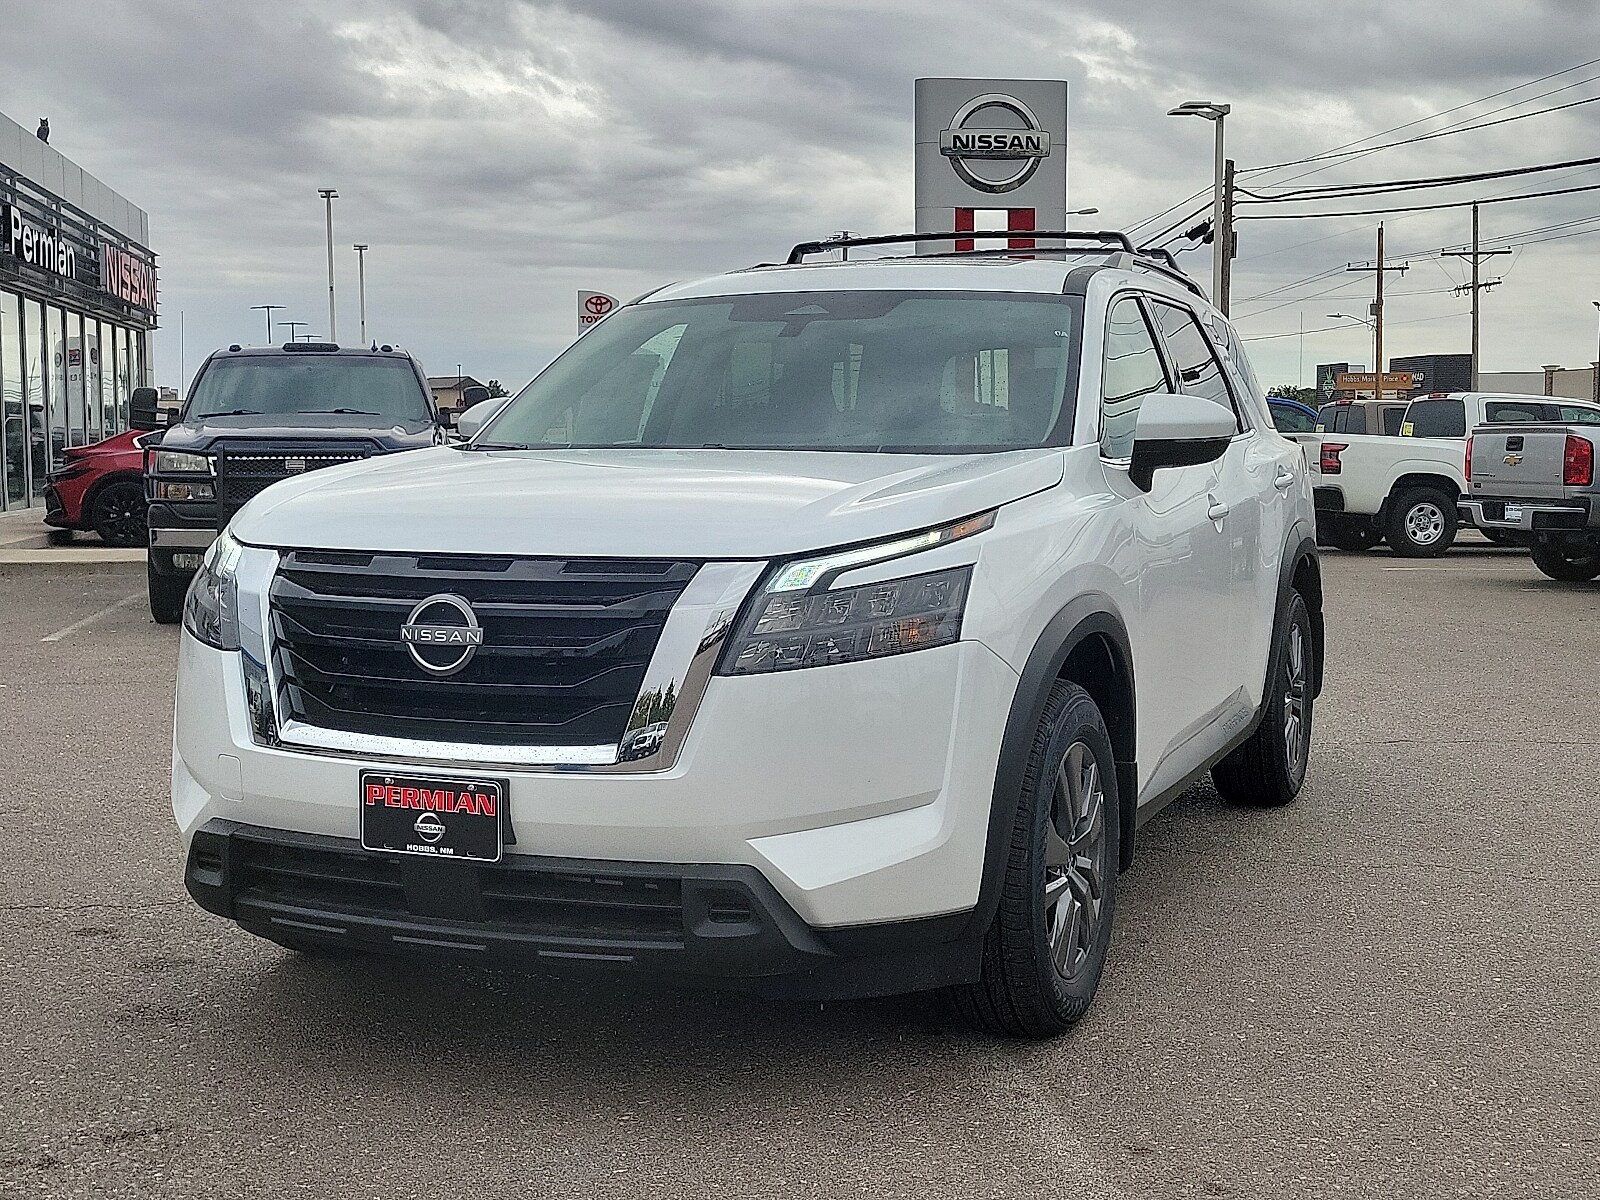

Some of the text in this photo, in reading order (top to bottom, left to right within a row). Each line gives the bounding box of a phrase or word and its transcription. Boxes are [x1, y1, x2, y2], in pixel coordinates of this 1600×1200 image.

[952, 134, 1040, 150] NISSAN
[10, 204, 76, 280] Permian
[105, 243, 157, 312] NISSAN
[580, 315, 604, 323] TOY
[402, 628, 480, 642] NISSAN
[366, 784, 496, 816] PERMIAN
[416, 824, 443, 832] NISSAN
[406, 844, 438, 853] HOBBS,
